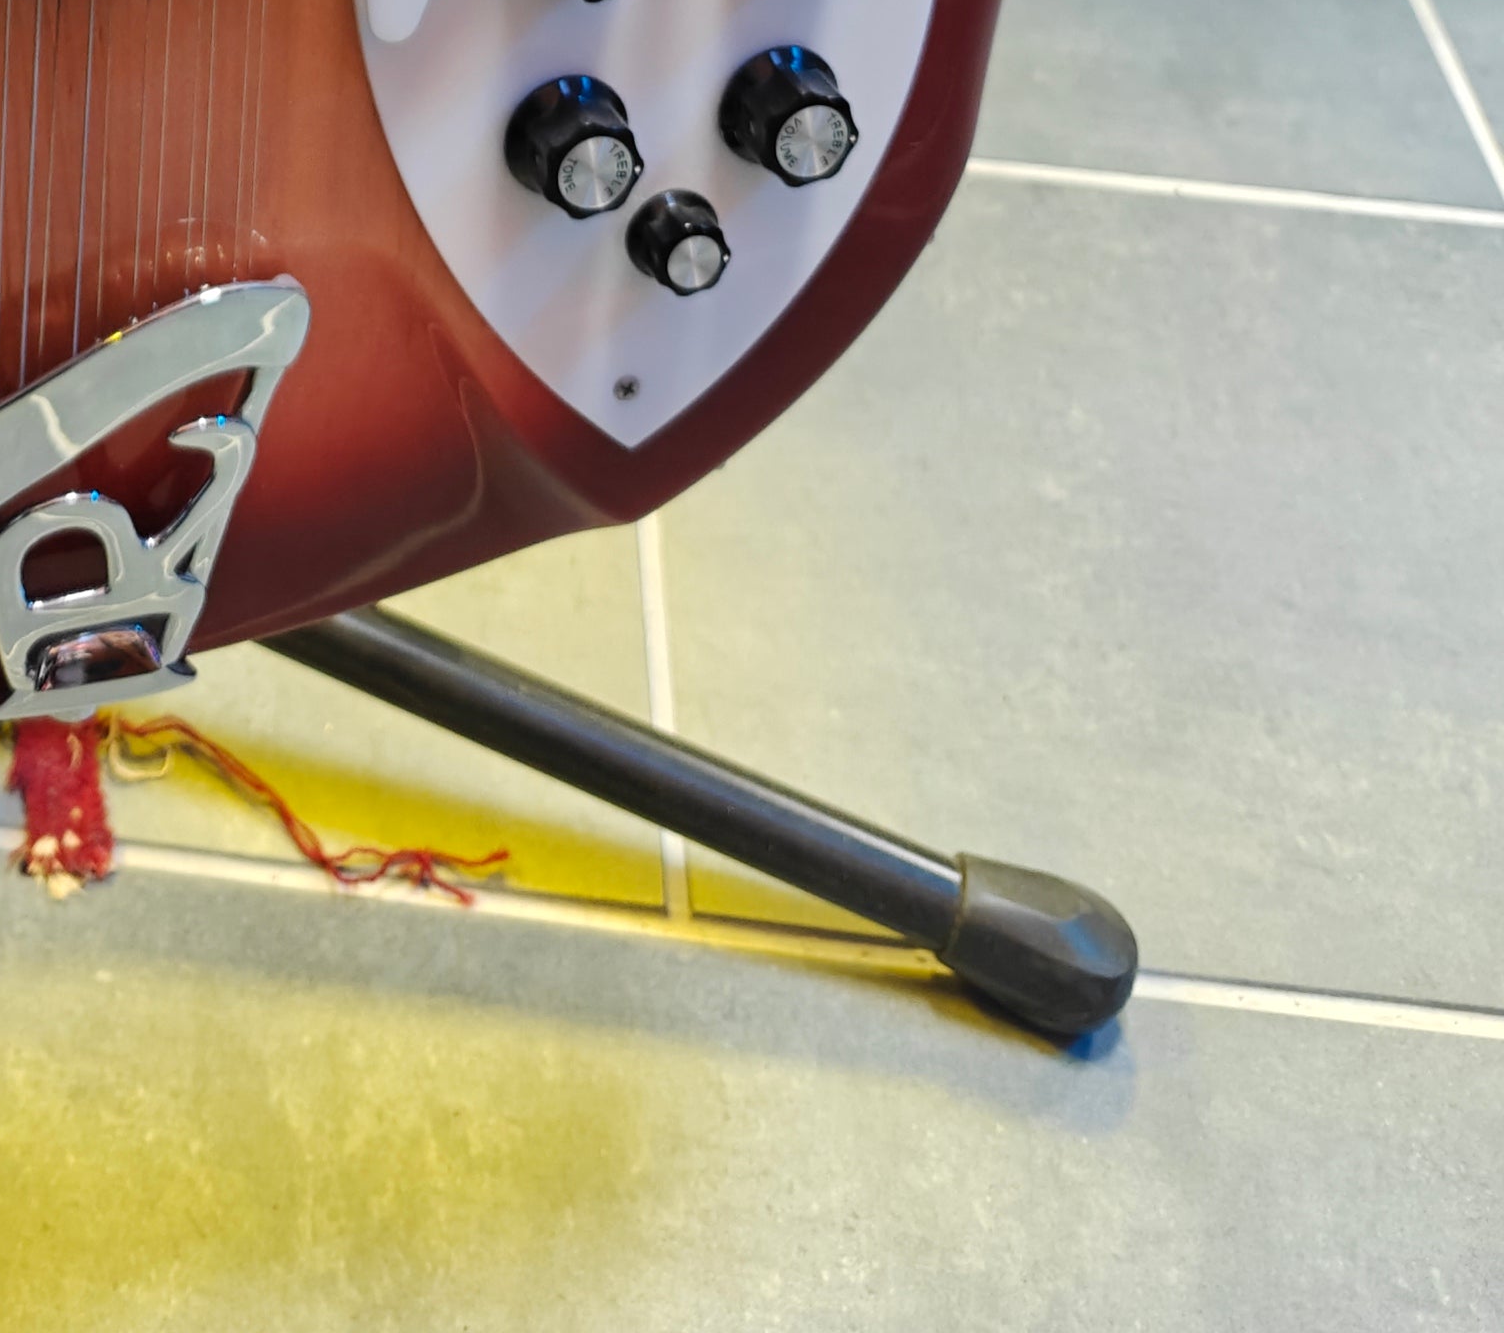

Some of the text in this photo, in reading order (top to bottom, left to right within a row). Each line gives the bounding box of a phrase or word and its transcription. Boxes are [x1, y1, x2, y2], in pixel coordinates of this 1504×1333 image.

[780, 117, 803, 168] VOLUME
[820, 111, 844, 167] TREBLE
[562, 157, 578, 193] TONE
[603, 142, 628, 198] TREBLE
